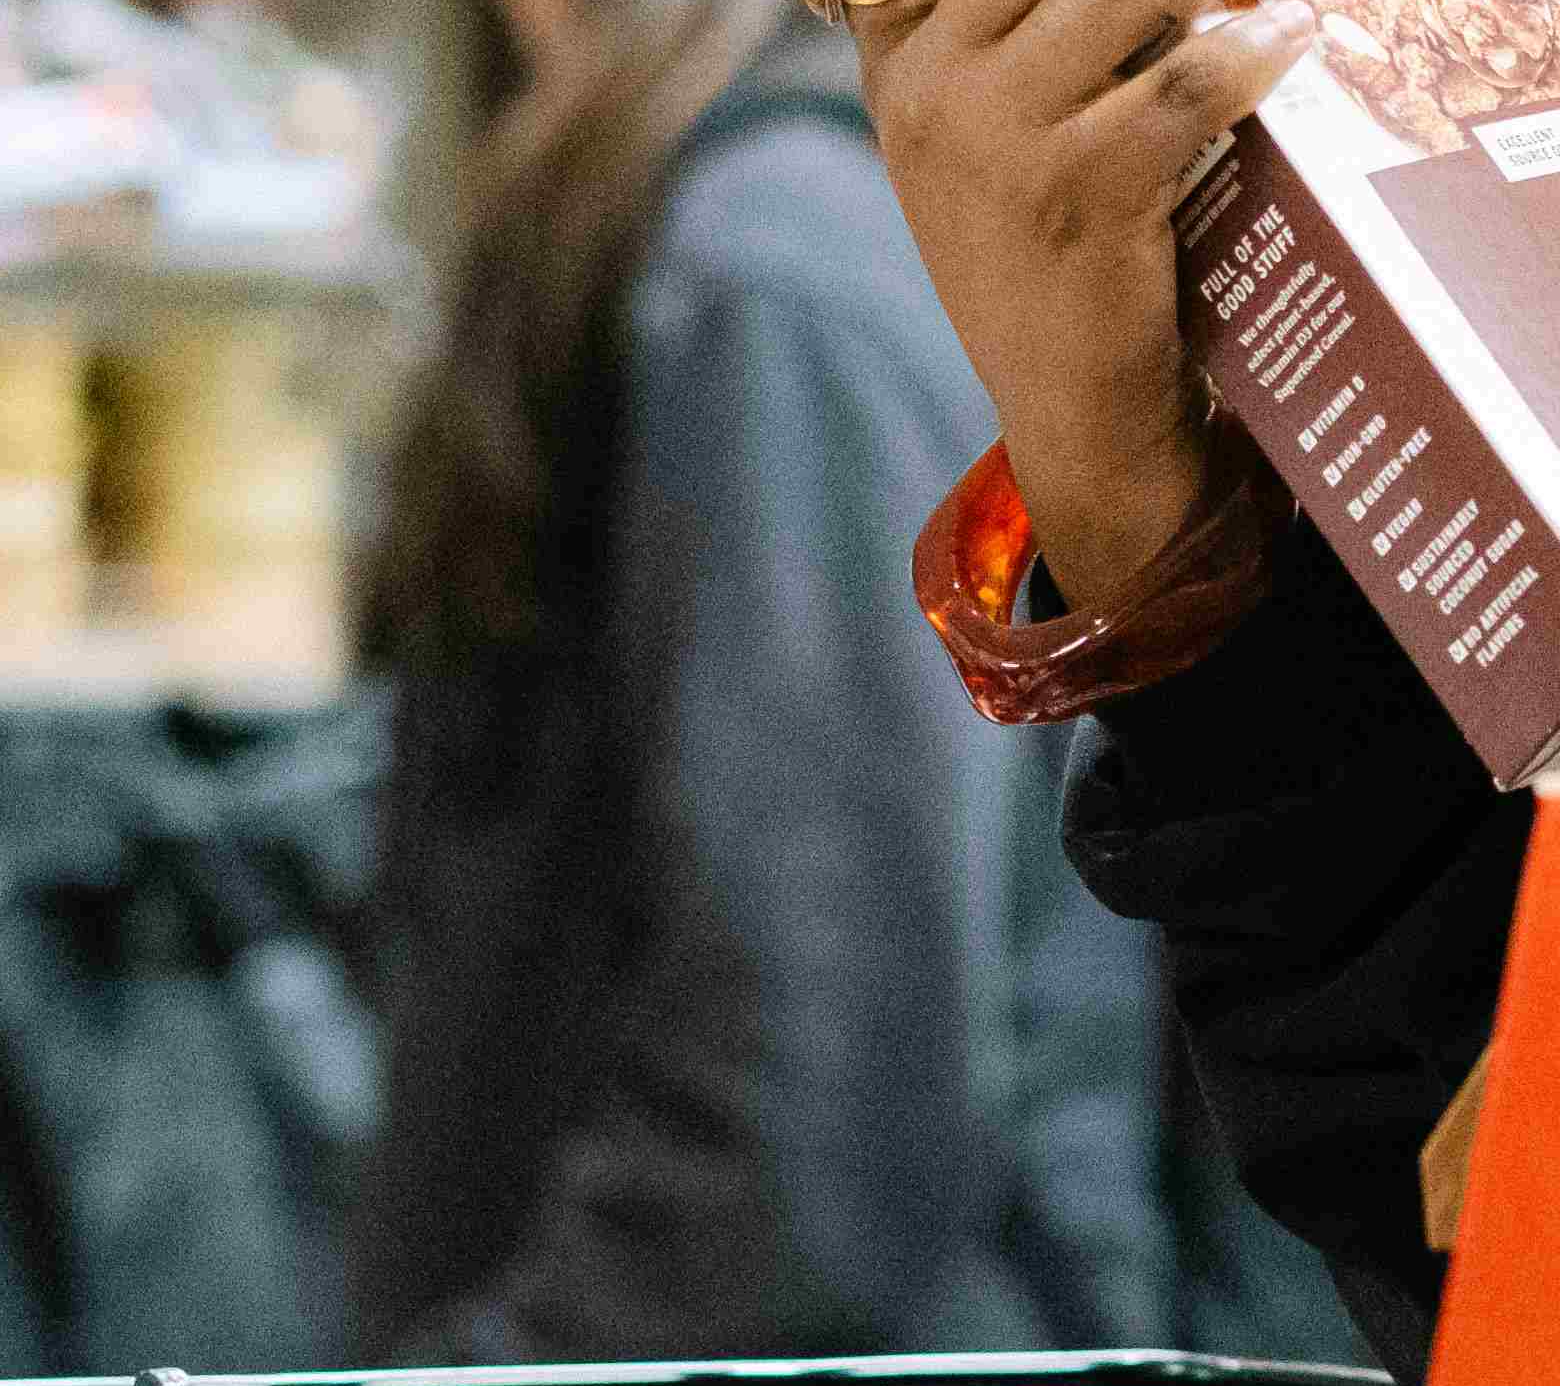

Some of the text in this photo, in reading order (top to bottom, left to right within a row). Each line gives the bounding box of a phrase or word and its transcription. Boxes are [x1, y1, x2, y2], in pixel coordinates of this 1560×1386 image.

[1199, 260, 1239, 303] FULL
[1233, 234, 1255, 264] OF
[1251, 203, 1286, 242] THE
[1216, 225, 1296, 321] GOOD STUFF
[1313, 384, 1356, 439] VITAMIN
[1361, 426, 1434, 509] GLUTEN-FREE
[1386, 497, 1426, 542] VEGAN
[1410, 499, 1481, 577] SUSTAINABLY
[1424, 539, 1477, 597] SOURCED
[1438, 556, 1489, 616] COCONUT
[1478, 565, 1540, 633] ARTIFICIAL
